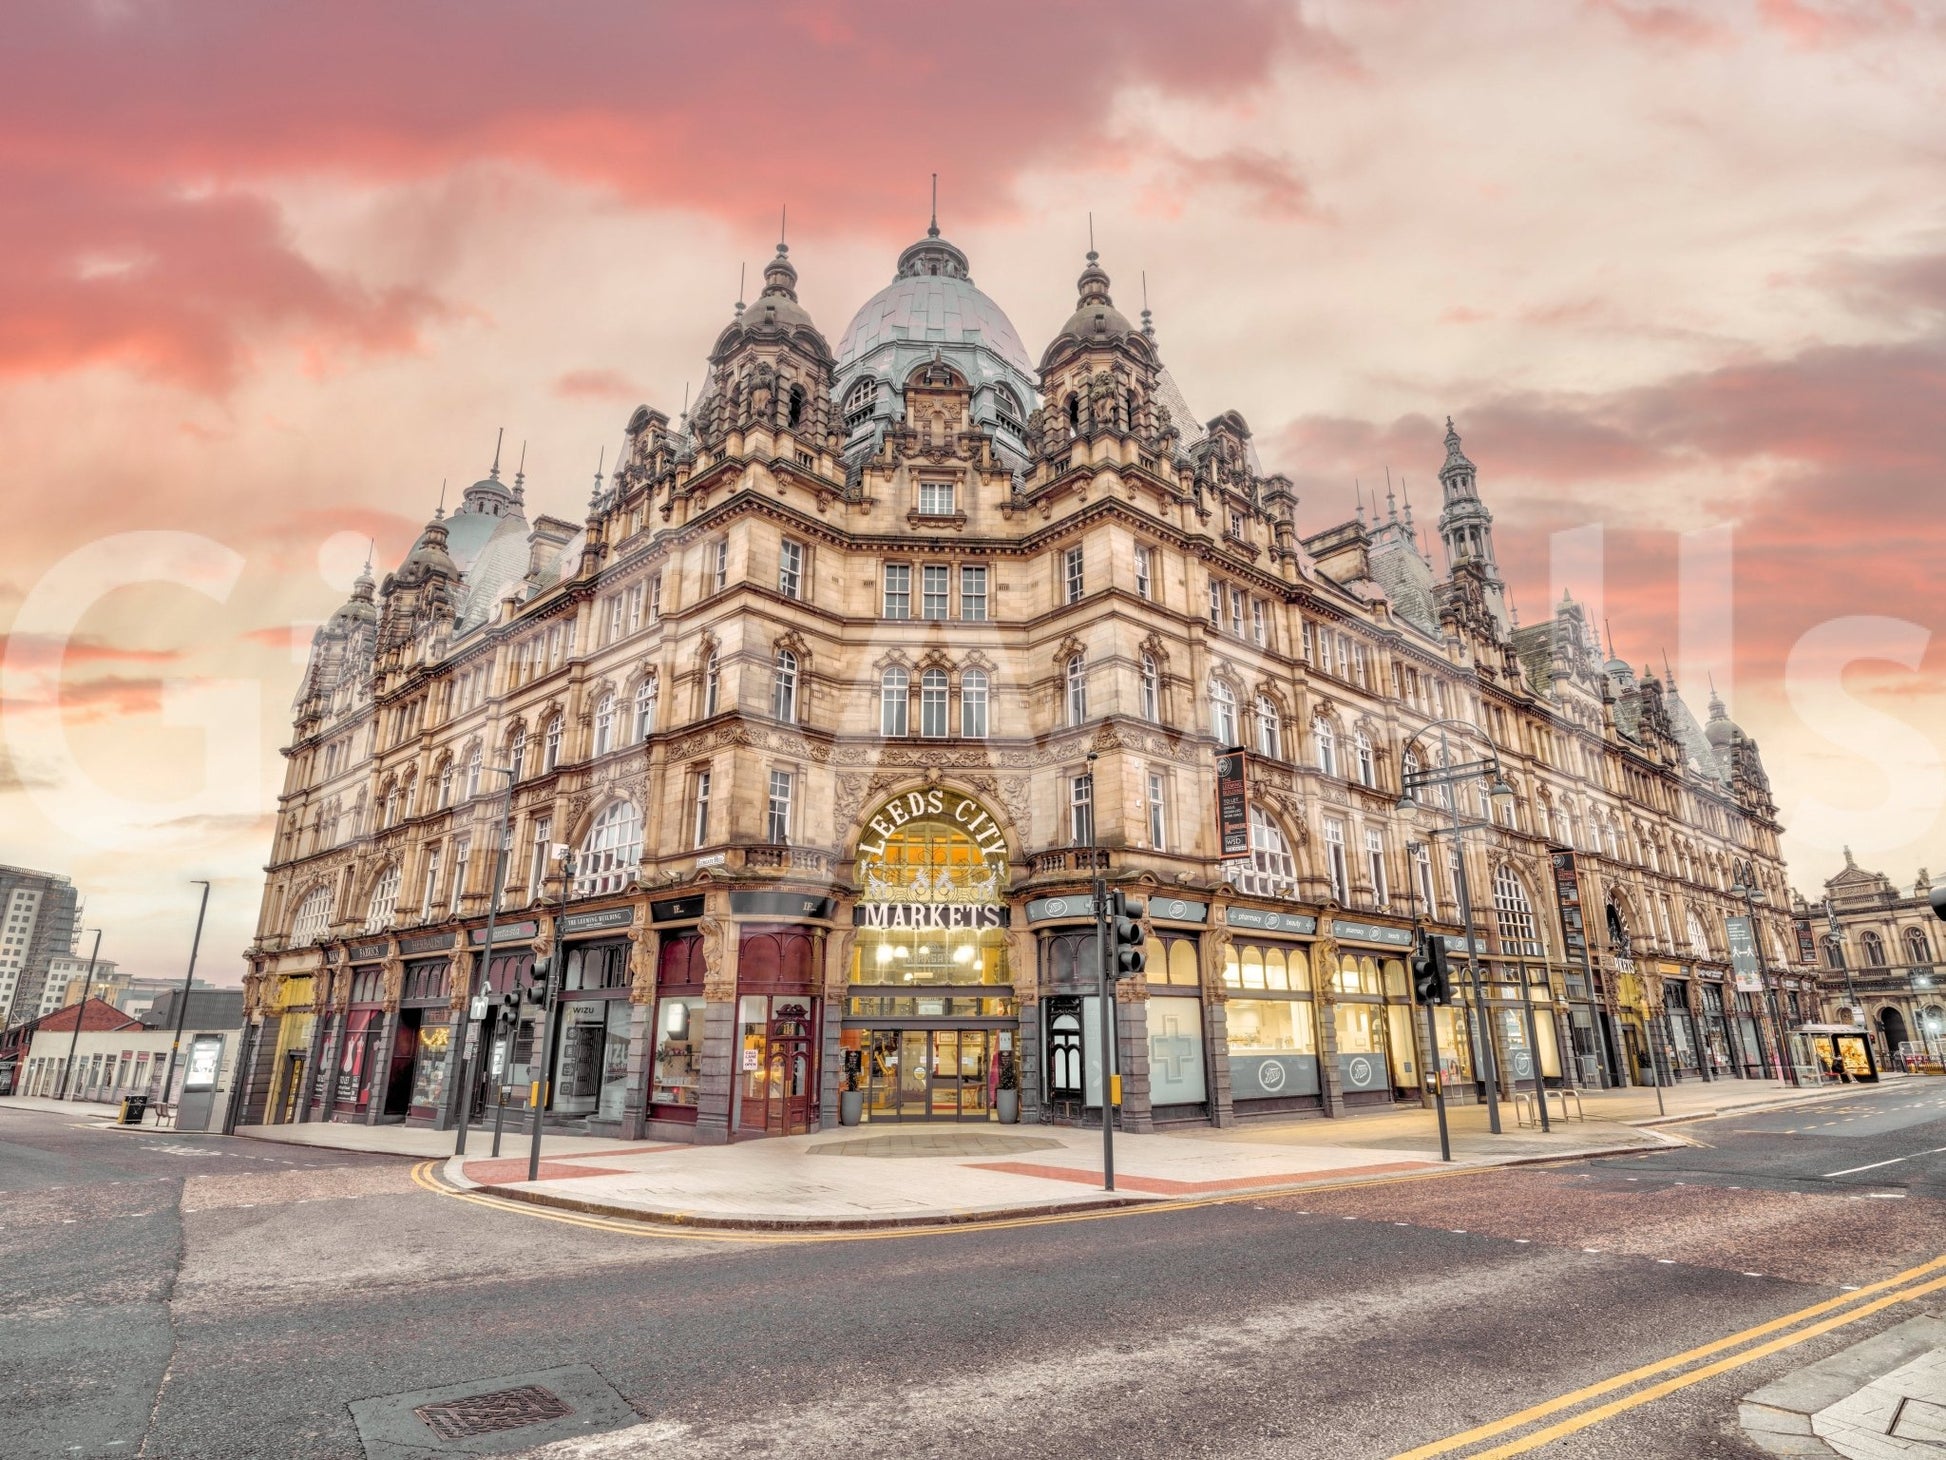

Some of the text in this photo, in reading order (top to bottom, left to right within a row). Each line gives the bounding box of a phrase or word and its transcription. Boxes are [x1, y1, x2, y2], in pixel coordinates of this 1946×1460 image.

[859, 790, 1006, 856] LEEDS CITY
[864, 904, 1001, 929] MARKETS
[1238, 914, 1261, 924] pharmacy
[1286, 919, 1301, 928] beauty
[572, 1006, 595, 1014] WIZU
